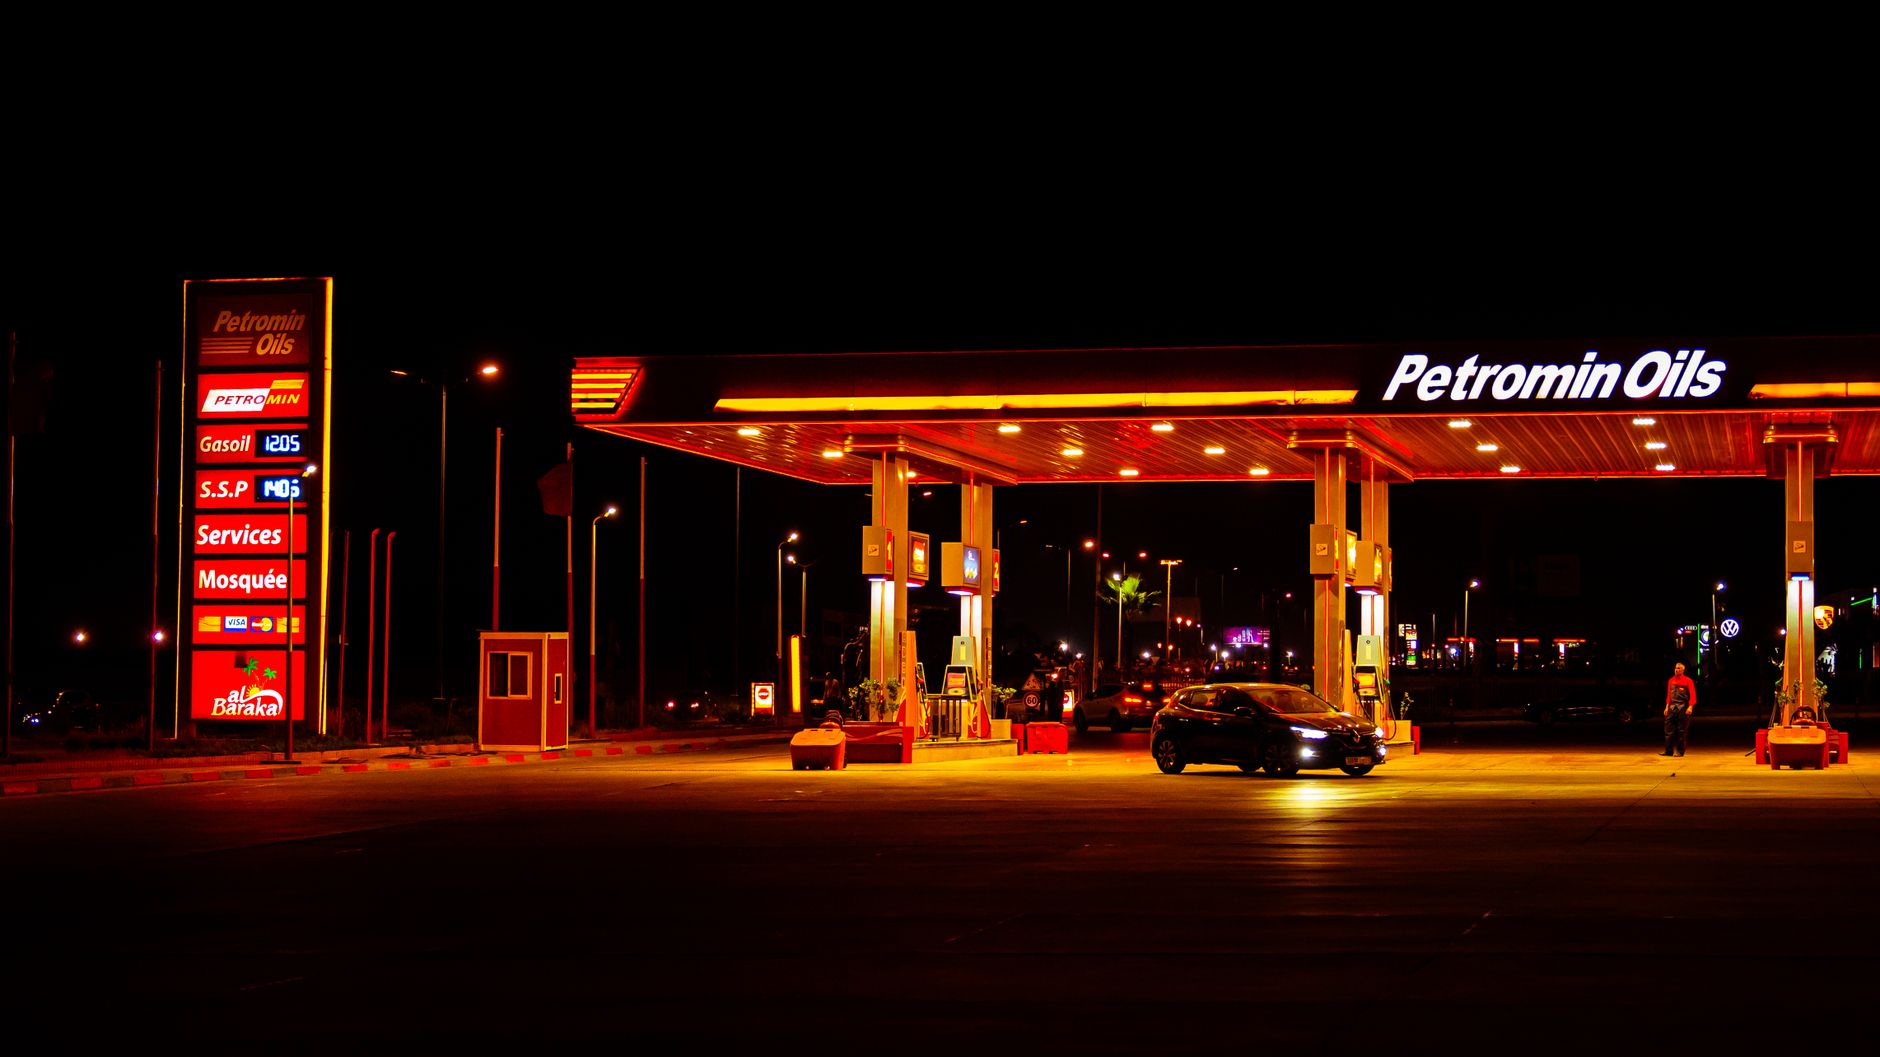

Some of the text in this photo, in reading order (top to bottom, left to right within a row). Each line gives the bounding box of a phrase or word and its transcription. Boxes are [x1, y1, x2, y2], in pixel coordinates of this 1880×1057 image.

[213, 309, 306, 333] Petromin
[256, 333, 295, 356] Oils
[1382, 350, 1726, 401] Petromin Oils
[214, 393, 301, 405] PETROMIN
[199, 434, 300, 453] Gasoil 1205
[199, 480, 249, 498] S.S.P
[196, 523, 282, 545] Services
[198, 568, 288, 594] Mosquée
[228, 618, 246, 626] VISA
[227, 685, 247, 704] al
[1027, 696, 1036, 705] 60
[210, 697, 278, 716] Baraka
